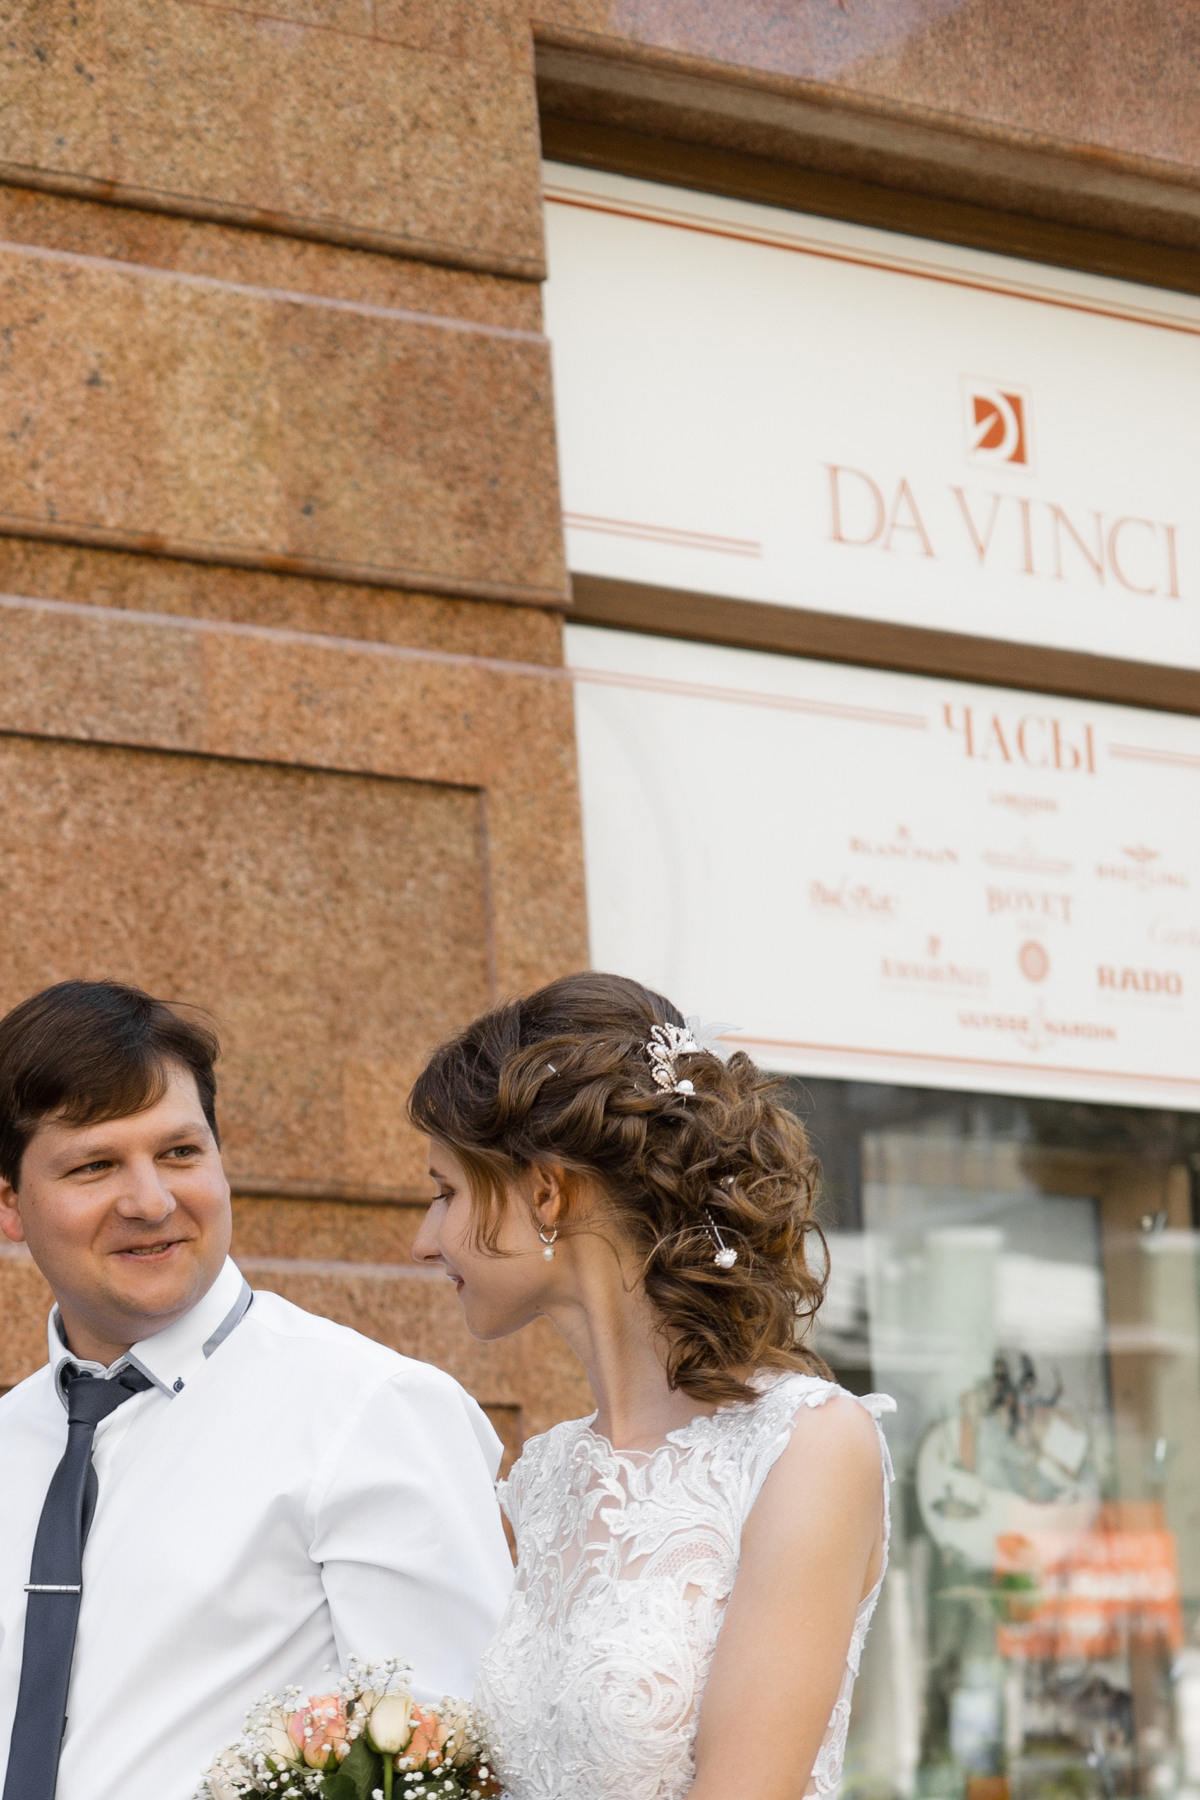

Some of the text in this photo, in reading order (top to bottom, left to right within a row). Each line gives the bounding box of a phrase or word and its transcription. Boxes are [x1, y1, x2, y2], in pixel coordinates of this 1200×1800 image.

[823, 462, 1183, 601] DA VINCI
[943, 702, 1097, 774] ЧАСЫ
[985, 884, 1074, 924] BOVET
[1096, 963, 1185, 997] RADO
